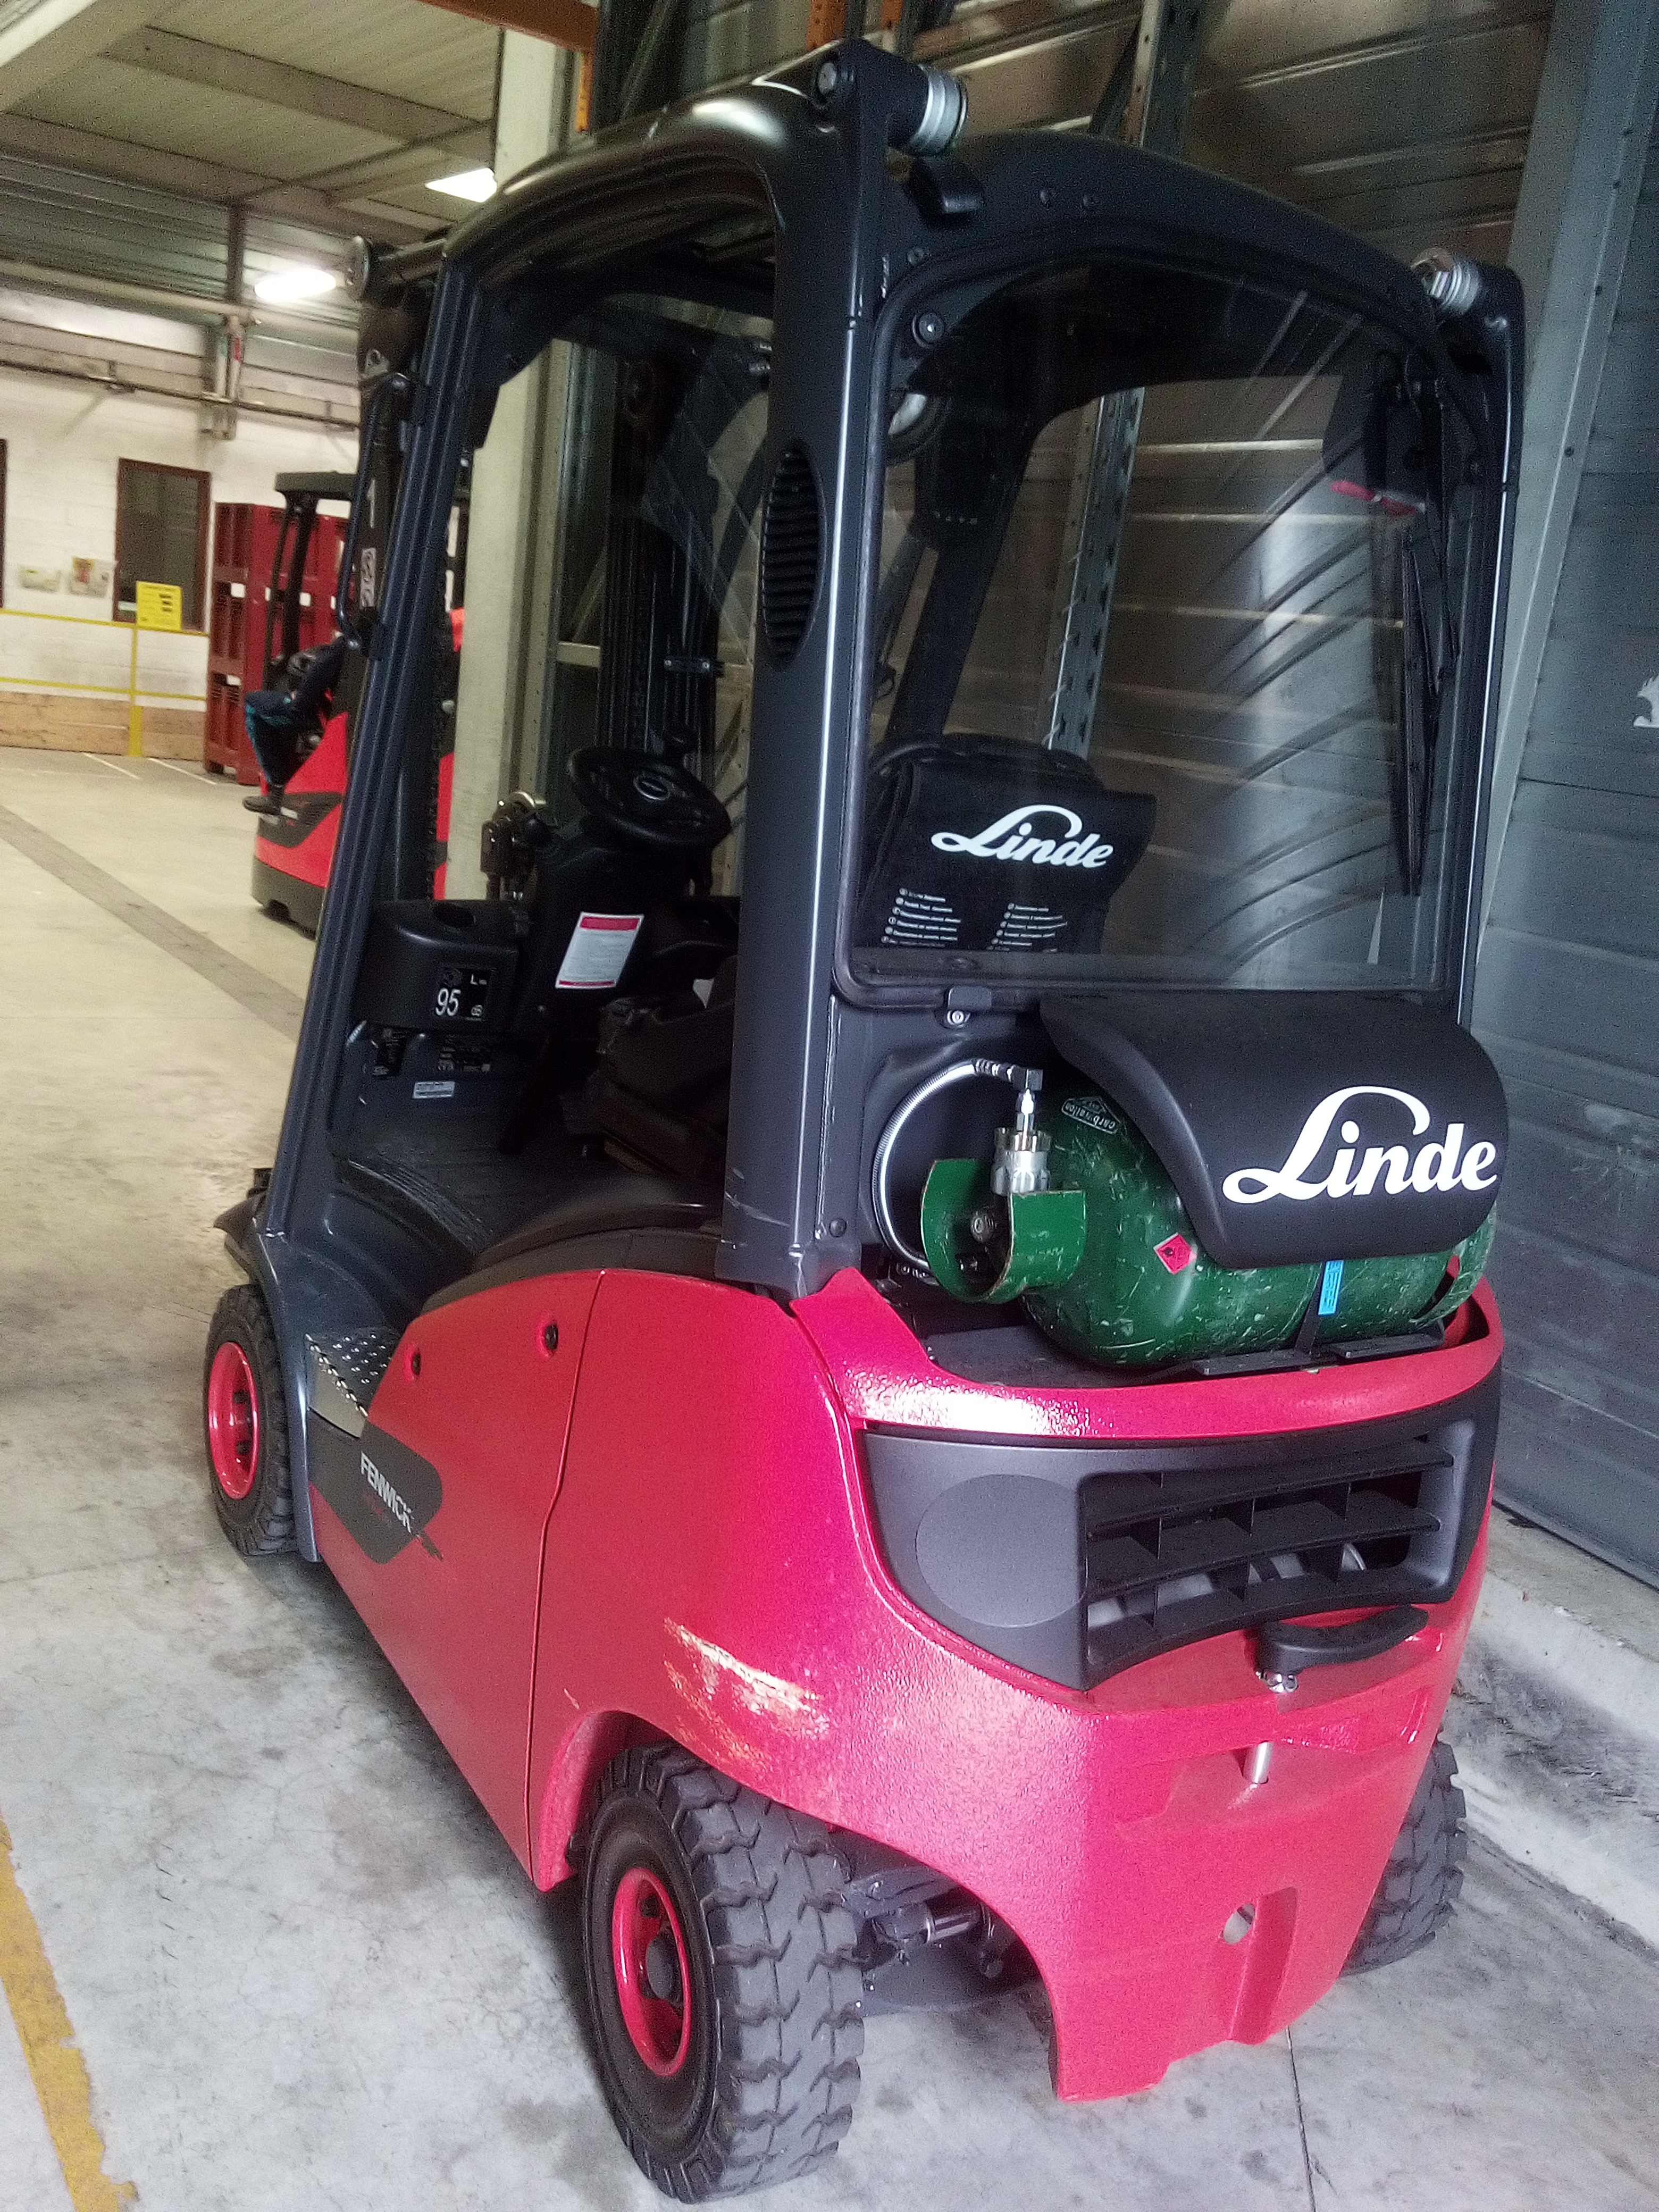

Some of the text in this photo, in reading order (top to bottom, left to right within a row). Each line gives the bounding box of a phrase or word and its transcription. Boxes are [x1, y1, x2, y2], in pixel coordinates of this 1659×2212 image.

[931, 805, 1113, 867] Linde
[435, 987, 461, 1016] 95
[1222, 1086, 1497, 1203] Linde
[361, 1451, 413, 1535] FENWICK
